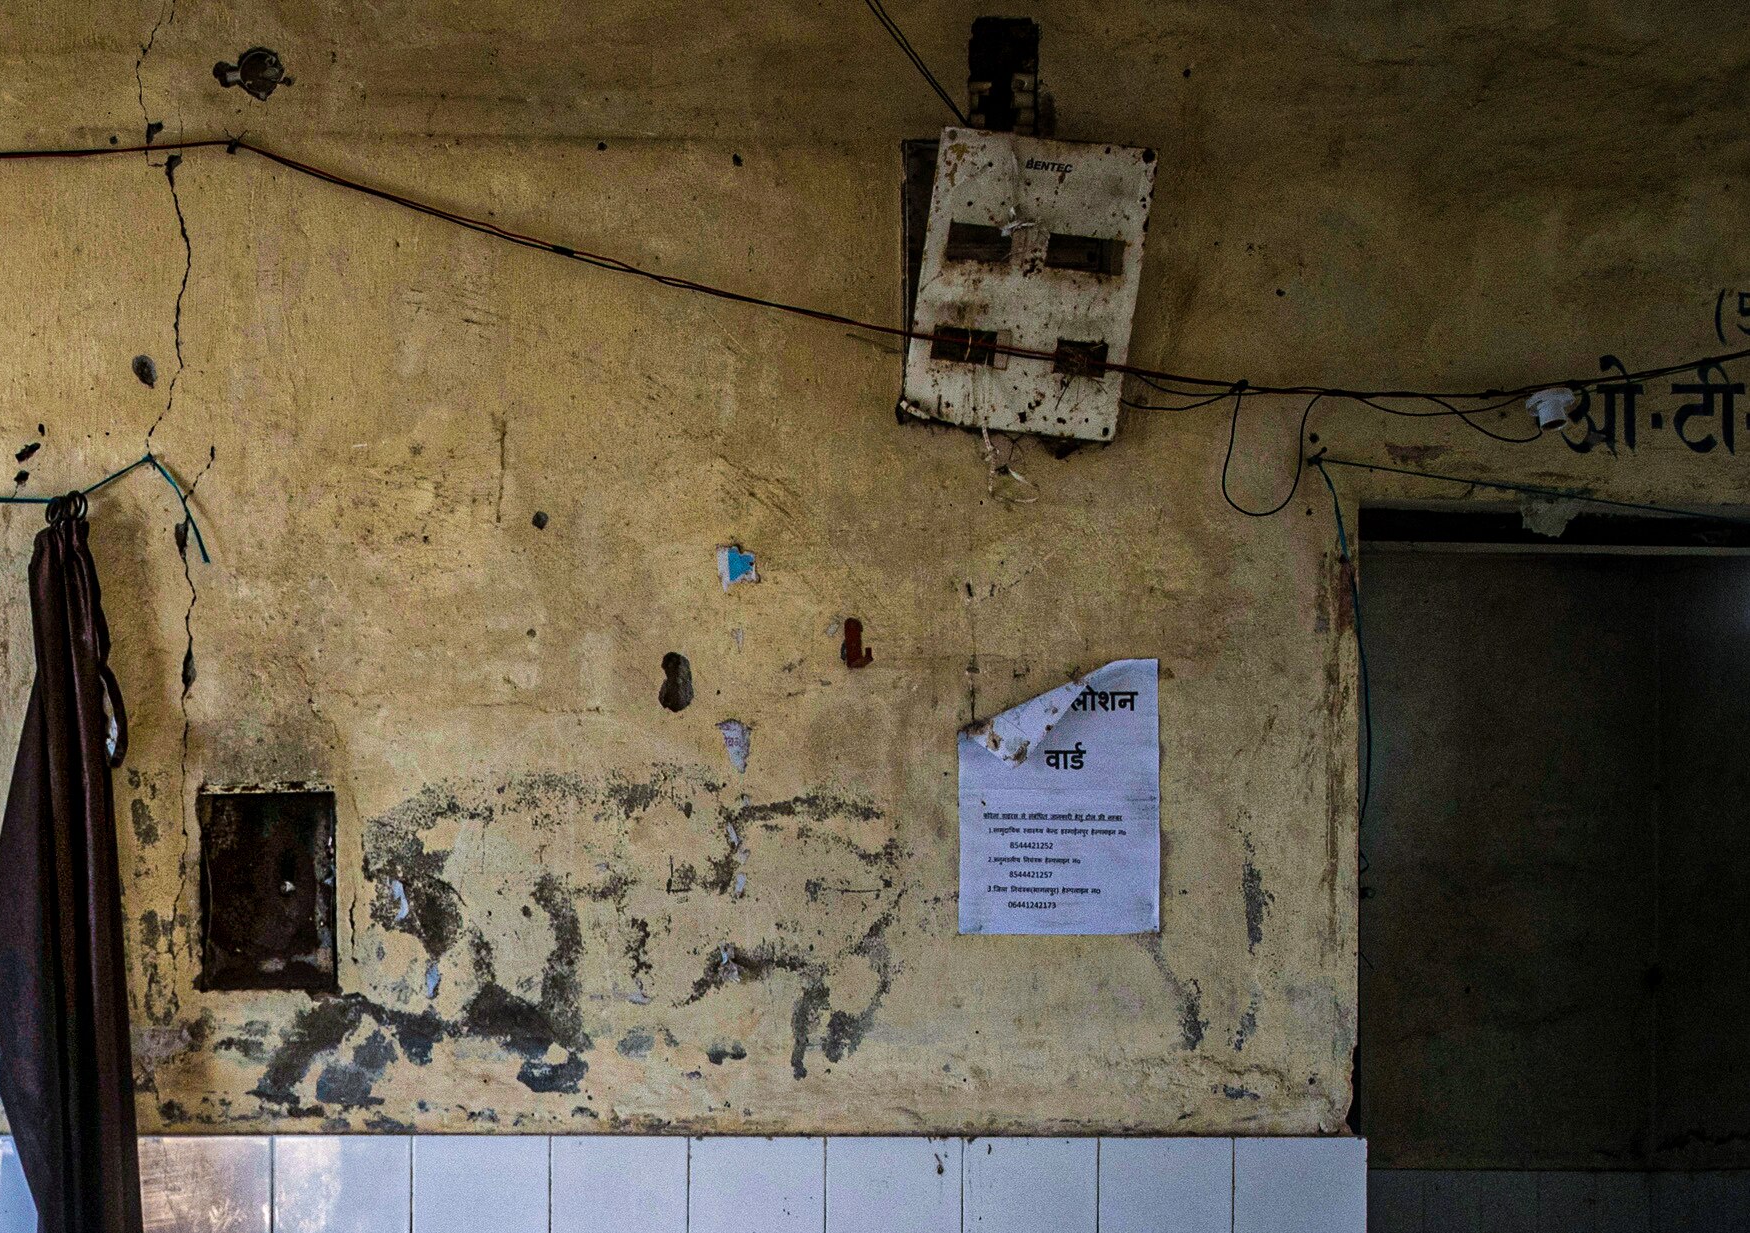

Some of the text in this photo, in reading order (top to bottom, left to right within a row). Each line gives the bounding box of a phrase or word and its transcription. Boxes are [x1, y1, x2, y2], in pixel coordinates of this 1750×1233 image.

[1025, 160, 1073, 173] BENTEC
[1044, 741, 1086, 770] वार्ड
[1007, 901, 1057, 909] 06441242173
